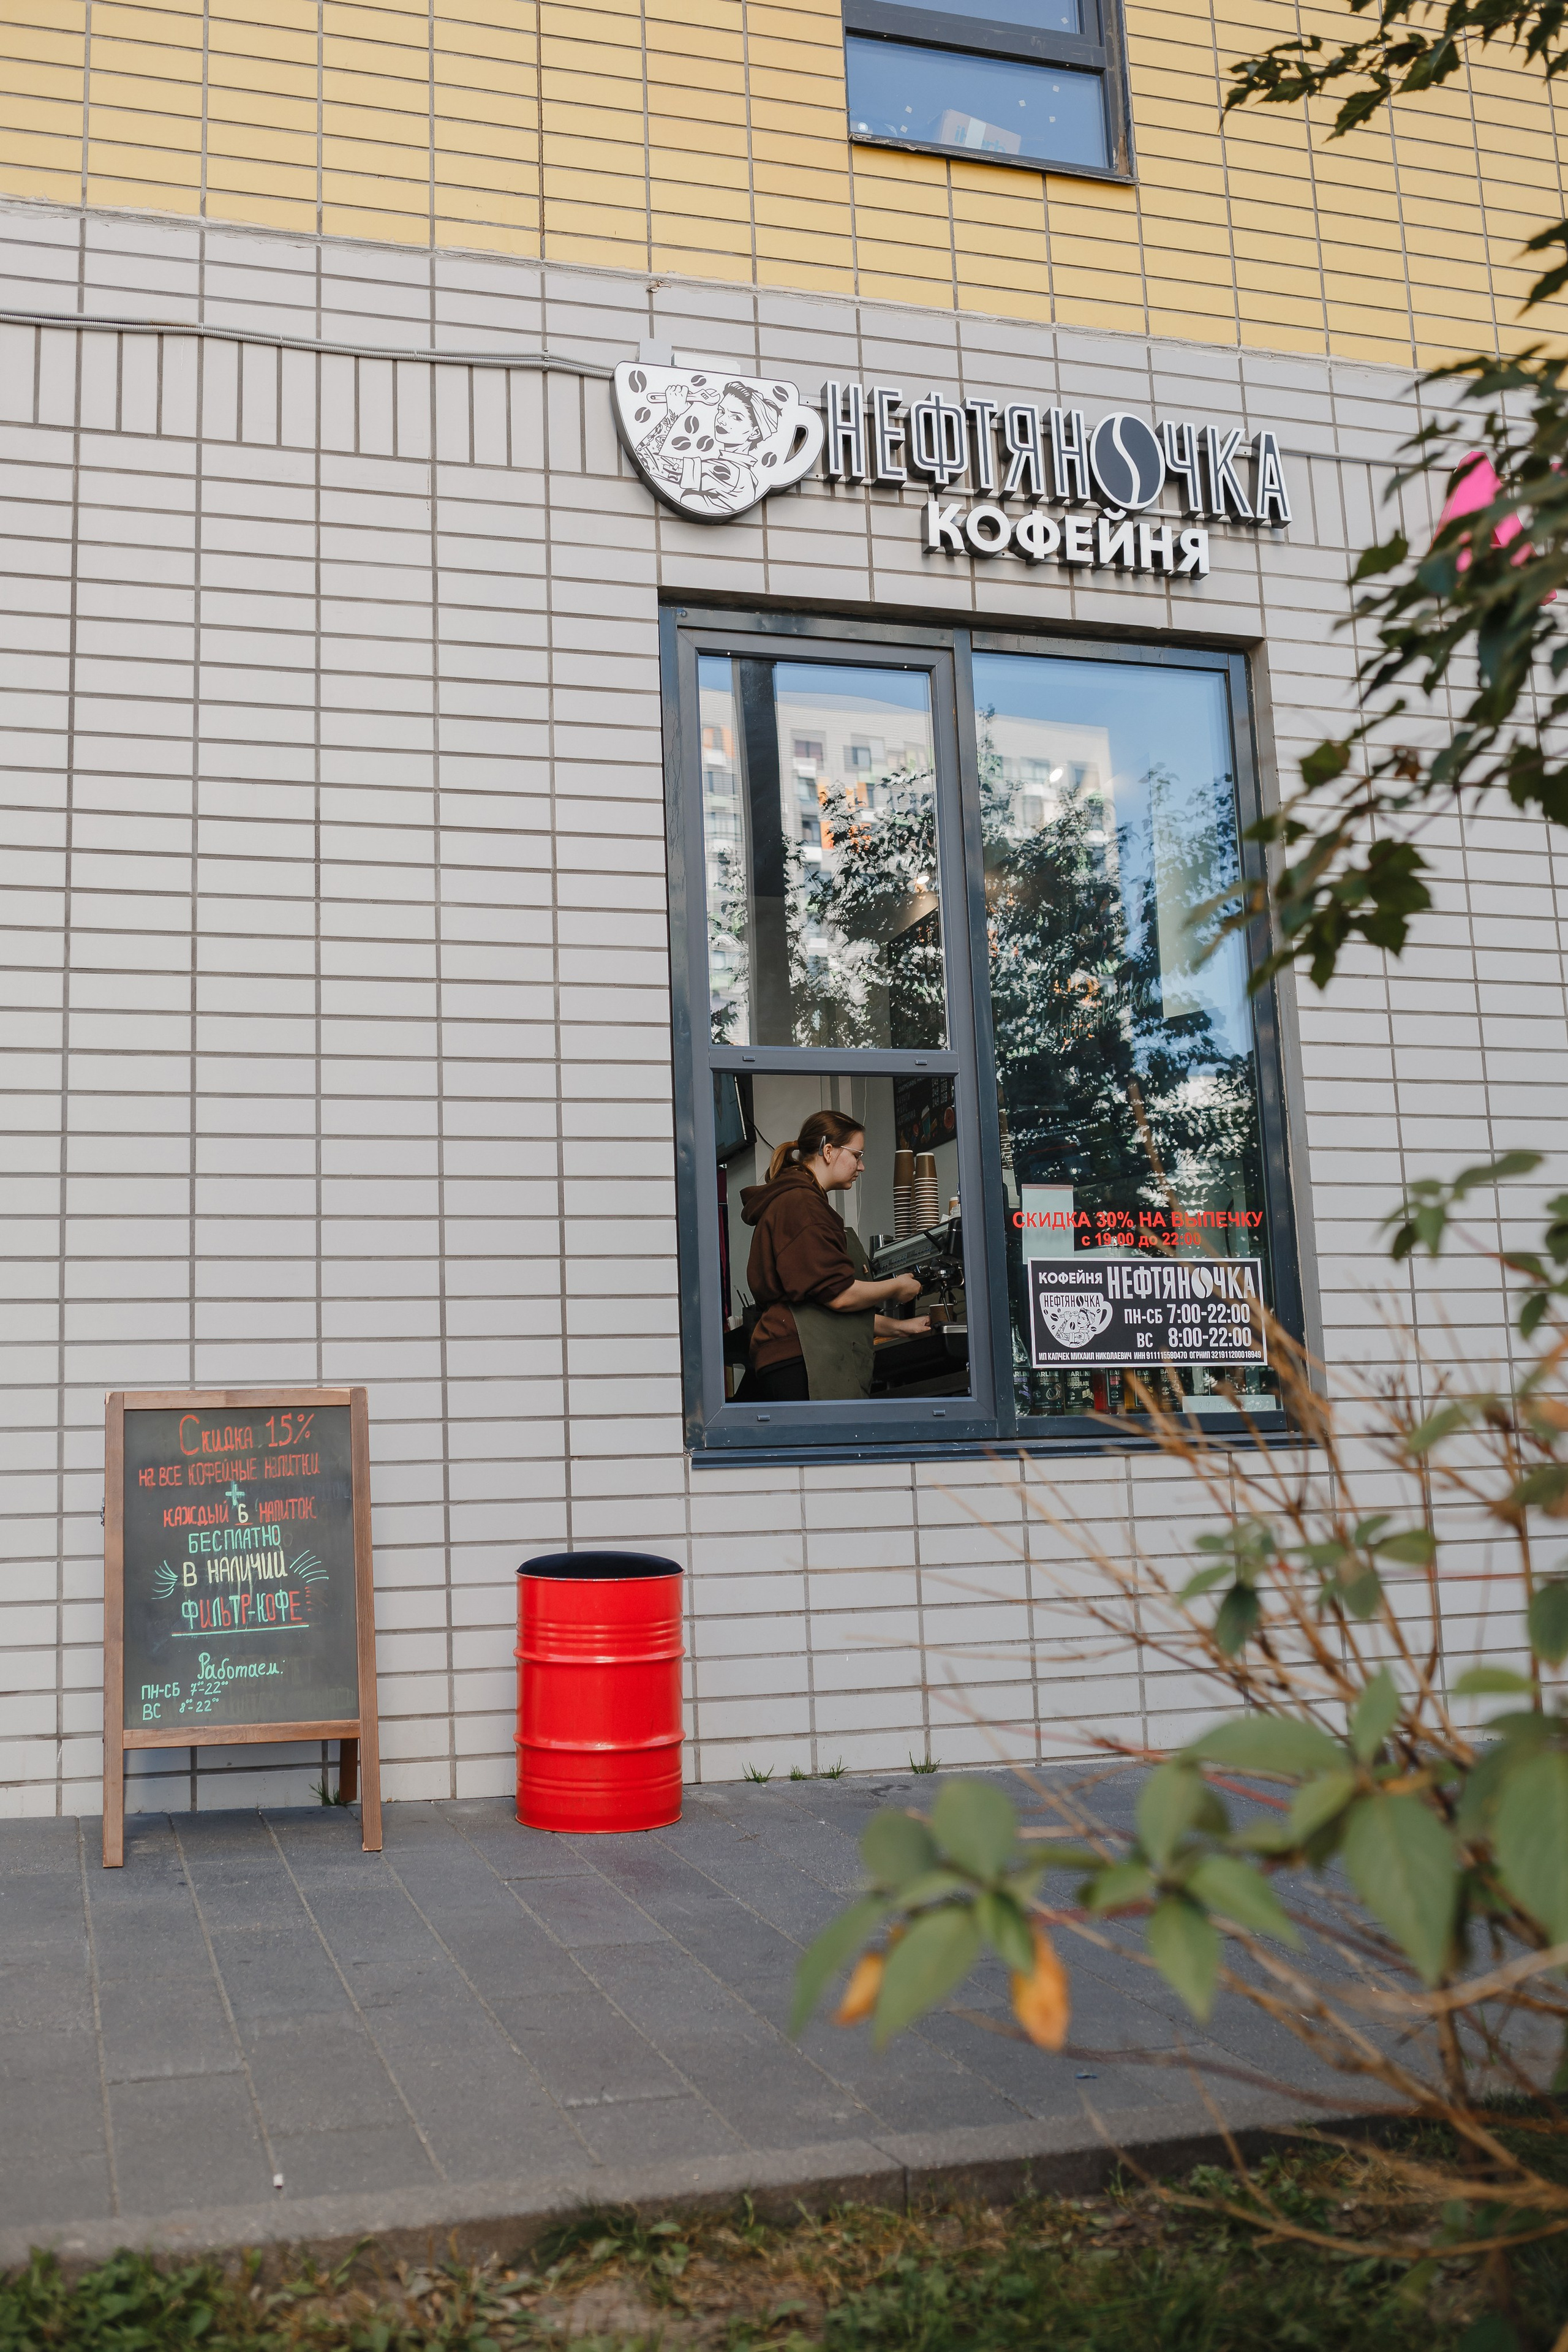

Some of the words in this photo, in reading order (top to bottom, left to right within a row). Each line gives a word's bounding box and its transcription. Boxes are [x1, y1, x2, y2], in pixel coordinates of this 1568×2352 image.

[825, 380, 1292, 524] НЕФТЯНОЧКА
[925, 500, 1210, 579] КОФЕЙНЯ
[1012, 1212, 1091, 1230] СКИДКА
[1096, 1212, 1134, 1228] 30%
[1139, 1212, 1166, 1227] НА
[1172, 1211, 1263, 1227] ВЫПЕЧКУ
[1082, 1235, 1090, 1246] с
[1095, 1232, 1134, 1246] 19:00
[1139, 1235, 1158, 1248] до
[1162, 1232, 1200, 1246] 22:00
[1039, 1269, 1103, 1284] КОФЕЙНЯ
[1107, 1266, 1256, 1299] НЕФТЯНОЧКА
[1044, 1295, 1100, 1308] НЕФТЯНОЧКА
[1124, 1308, 1163, 1324] ПН-СБ
[1167, 1303, 1250, 1324] 7:00-22:00
[1136, 1333, 1153, 1348] ВС
[1168, 1327, 1252, 1348] 8:00-22:00
[1134, 1351, 1146, 1360] ИНН
[265, 1412, 315, 1447] 15%
[159, 1465, 183, 1487] ВСЕ
[188, 1458, 257, 1486] КОФЕЙНЫЕ
[163, 1500, 229, 1528] КАЖДЫЙ
[238, 1504, 249, 1524] 6
[259, 1496, 317, 1524] НАПИТОК
[188, 1525, 281, 1554] БЕСПЛАТНО
[183, 1561, 198, 1587] В
[207, 1550, 288, 1584] НАЛИЧИИ
[181, 1589, 303, 1630] ФИЛЬТР-КОФЕ
[141, 1682, 181, 1700] ПН-СБ
[142, 1703, 161, 1721] ВС
